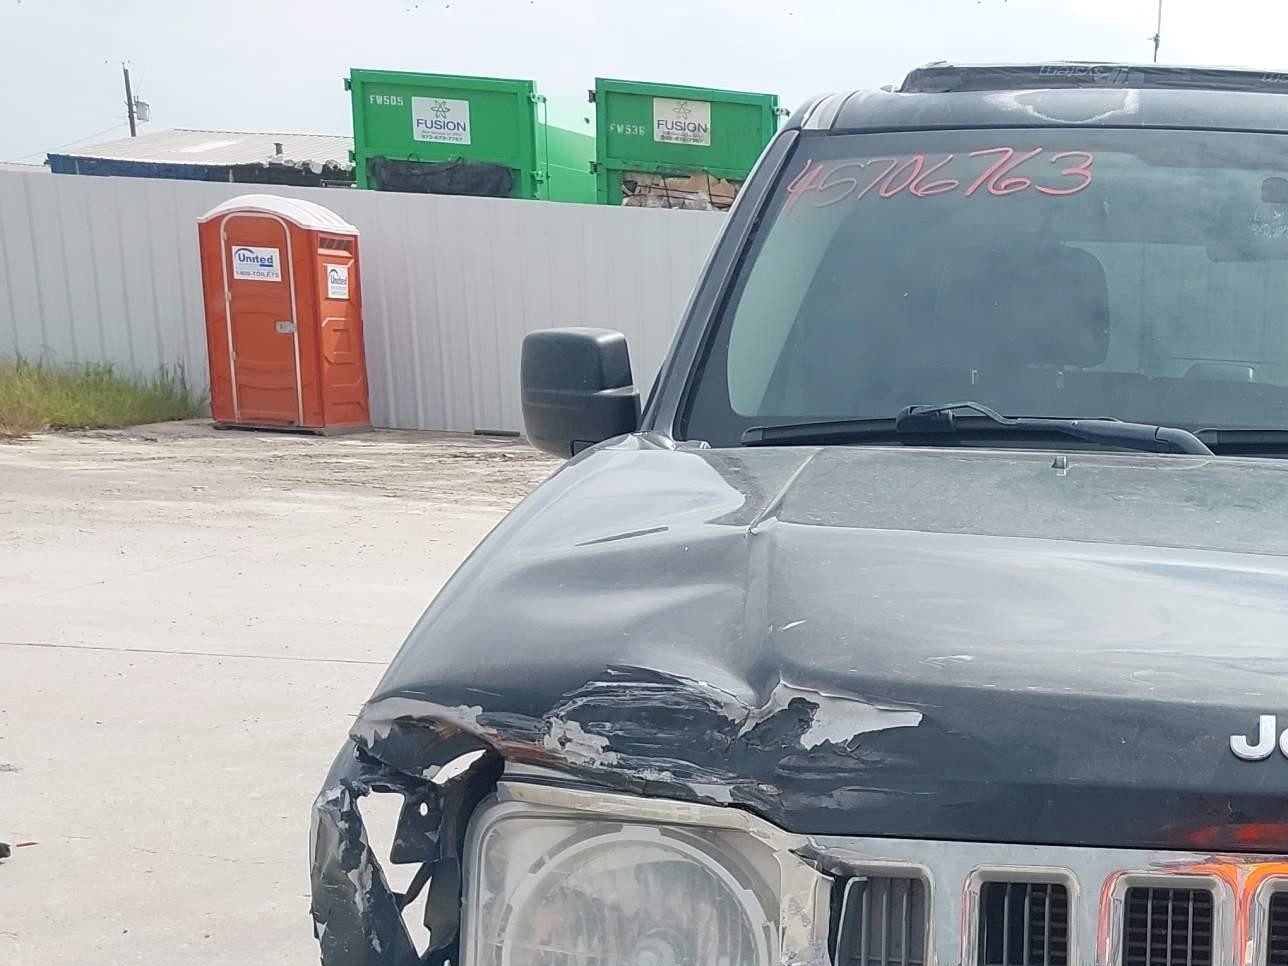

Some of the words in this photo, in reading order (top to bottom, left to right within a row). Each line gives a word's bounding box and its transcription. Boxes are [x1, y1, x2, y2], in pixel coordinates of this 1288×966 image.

[415, 118, 467, 132] FUSION
[657, 119, 708, 134] FUSION
[786, 146, 1095, 209] 45706763
[238, 253, 274, 265] United
